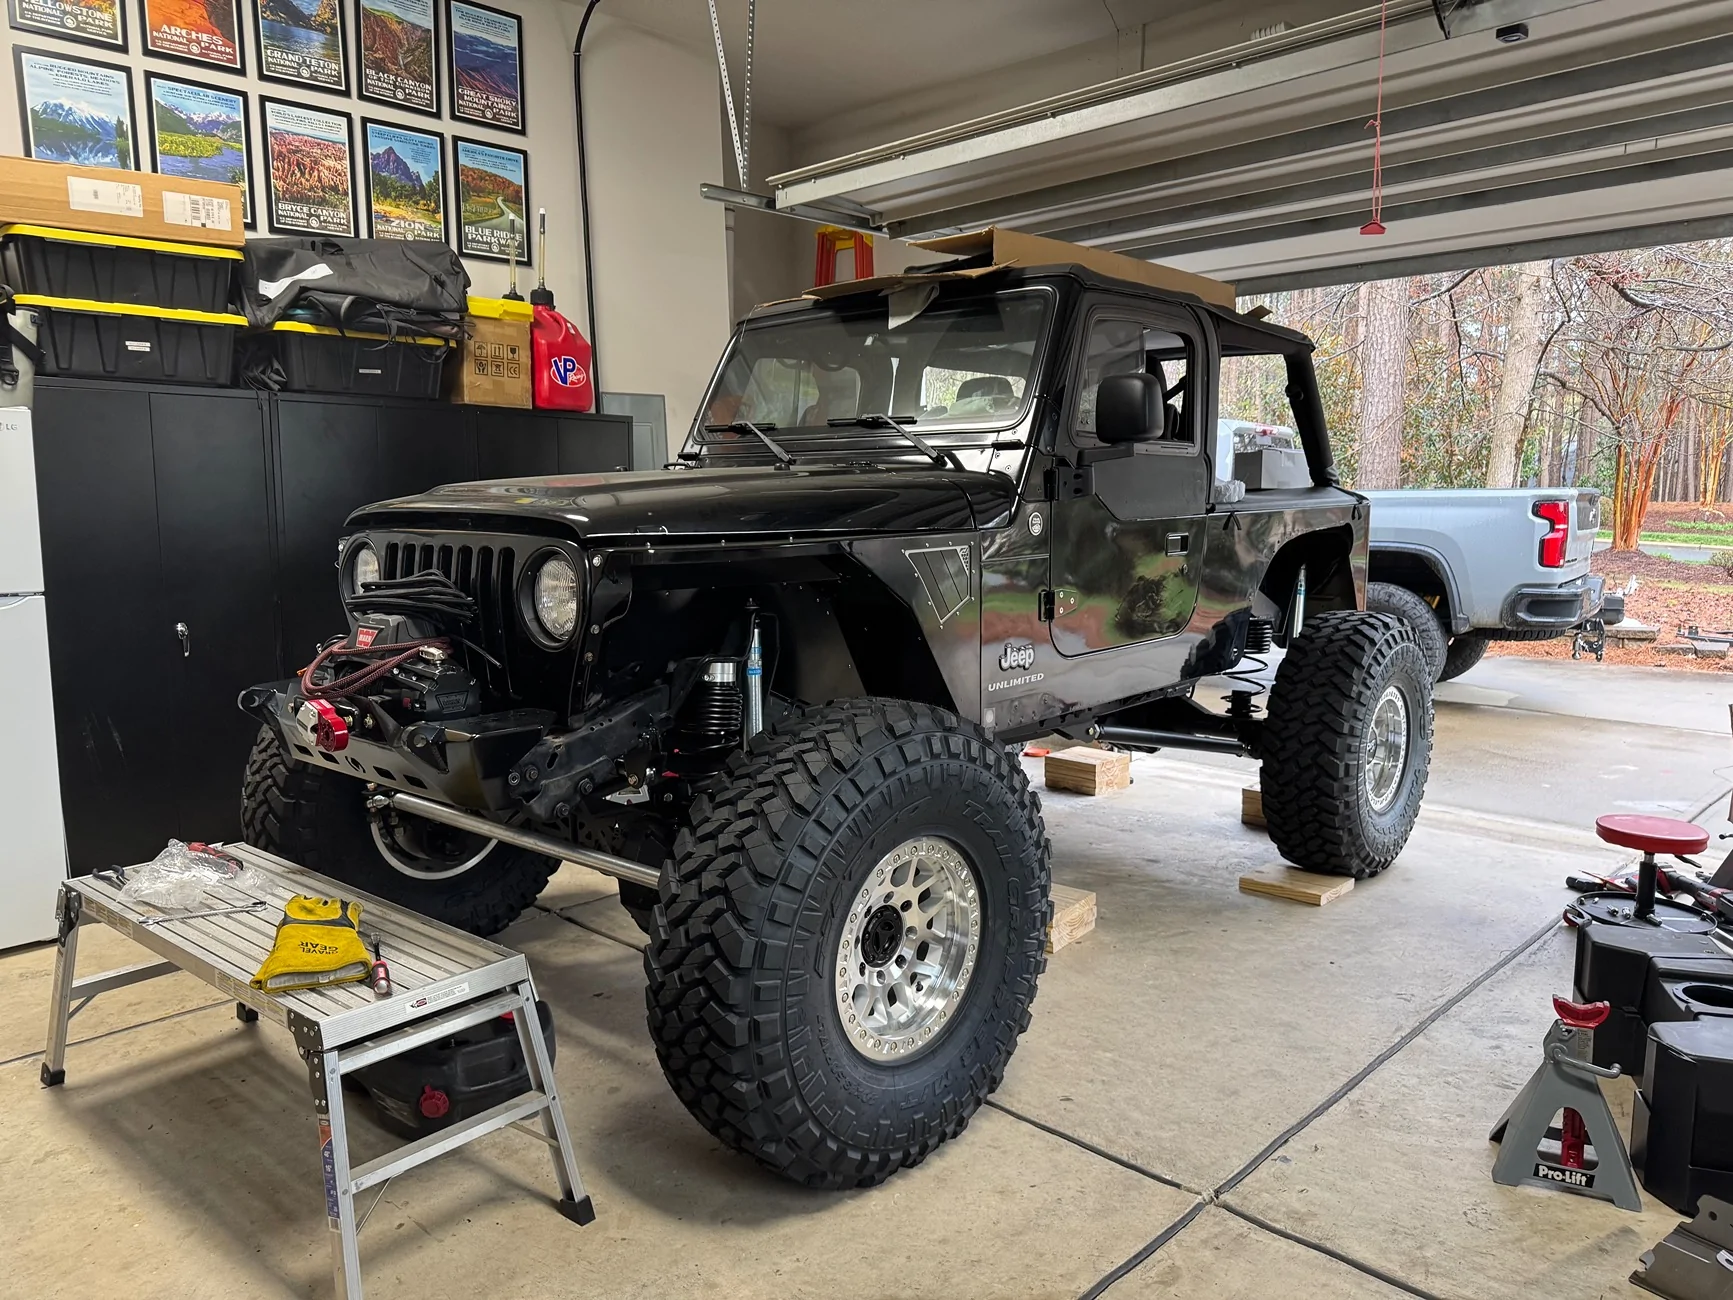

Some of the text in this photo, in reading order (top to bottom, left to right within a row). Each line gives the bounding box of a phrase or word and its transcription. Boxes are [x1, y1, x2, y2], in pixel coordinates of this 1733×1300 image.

[22, 2, 64, 16] NATIONAL
[25, 0, 113, 21] ELLOWSTONE
[78, 15, 113, 28] PARK
[152, 31, 189, 44] NATIONAL
[161, 24, 223, 45] ARCHES
[201, 41, 233, 53] PARK
[267, 49, 302, 63] GRAND
[303, 57, 339, 70] TETON
[268, 57, 299, 68] NATIONAL
[311, 66, 339, 76] PARK
[366, 68, 396, 81] BLACK
[397, 77, 432, 91] CANYON
[367, 79, 395, 90] NATIONAL
[405, 88, 431, 99] PARK
[458, 88, 517, 106] GREAT SMOKY
[458, 99, 485, 110] NATIONAL
[464, 95, 512, 111] MOUNTAINS
[493, 108, 517, 118] PARK
[278, 203, 346, 219] BRYCE CANYON
[278, 210, 309, 219] NATIONAL
[320, 216, 348, 225] PARK
[390, 220, 425, 230] ZION
[377, 224, 405, 233] NATIONAL
[414, 230, 440, 238] PARK
[465, 225, 492, 236] BLUE
[551, 356, 577, 387] VP
[5, 423, 18, 431] LG
[1000, 644, 1035, 671] Jeep
[988, 673, 1045, 692] UNLIMITED
[301, 941, 338, 951] GEAR
[1538, 1165, 1587, 1186] Pro-Lift
